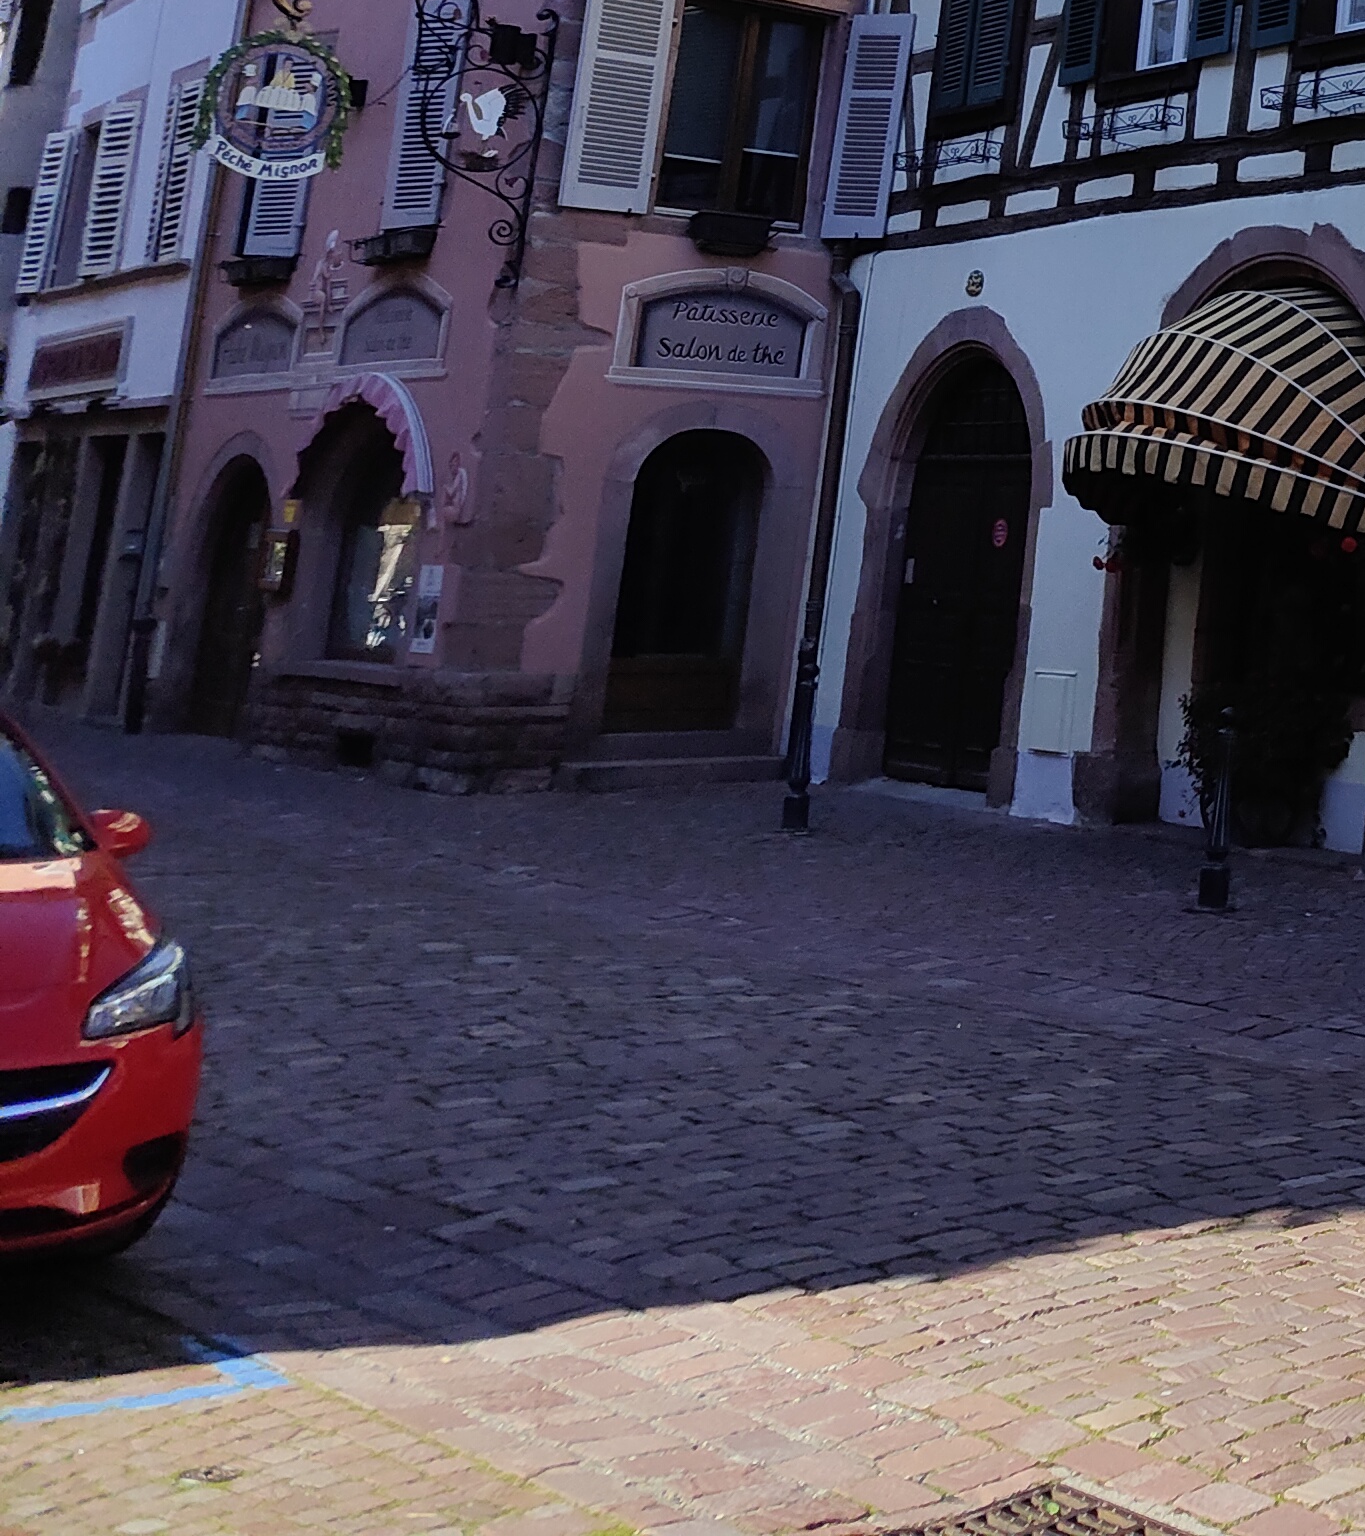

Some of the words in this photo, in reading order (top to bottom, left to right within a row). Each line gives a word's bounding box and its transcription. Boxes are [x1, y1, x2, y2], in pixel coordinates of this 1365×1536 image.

[214, 140, 252, 173] Péché
[672, 300, 779, 328] Pâtisserie
[657, 336, 722, 362] Salon
[727, 345, 747, 363] de
[752, 342, 786, 366] thé
